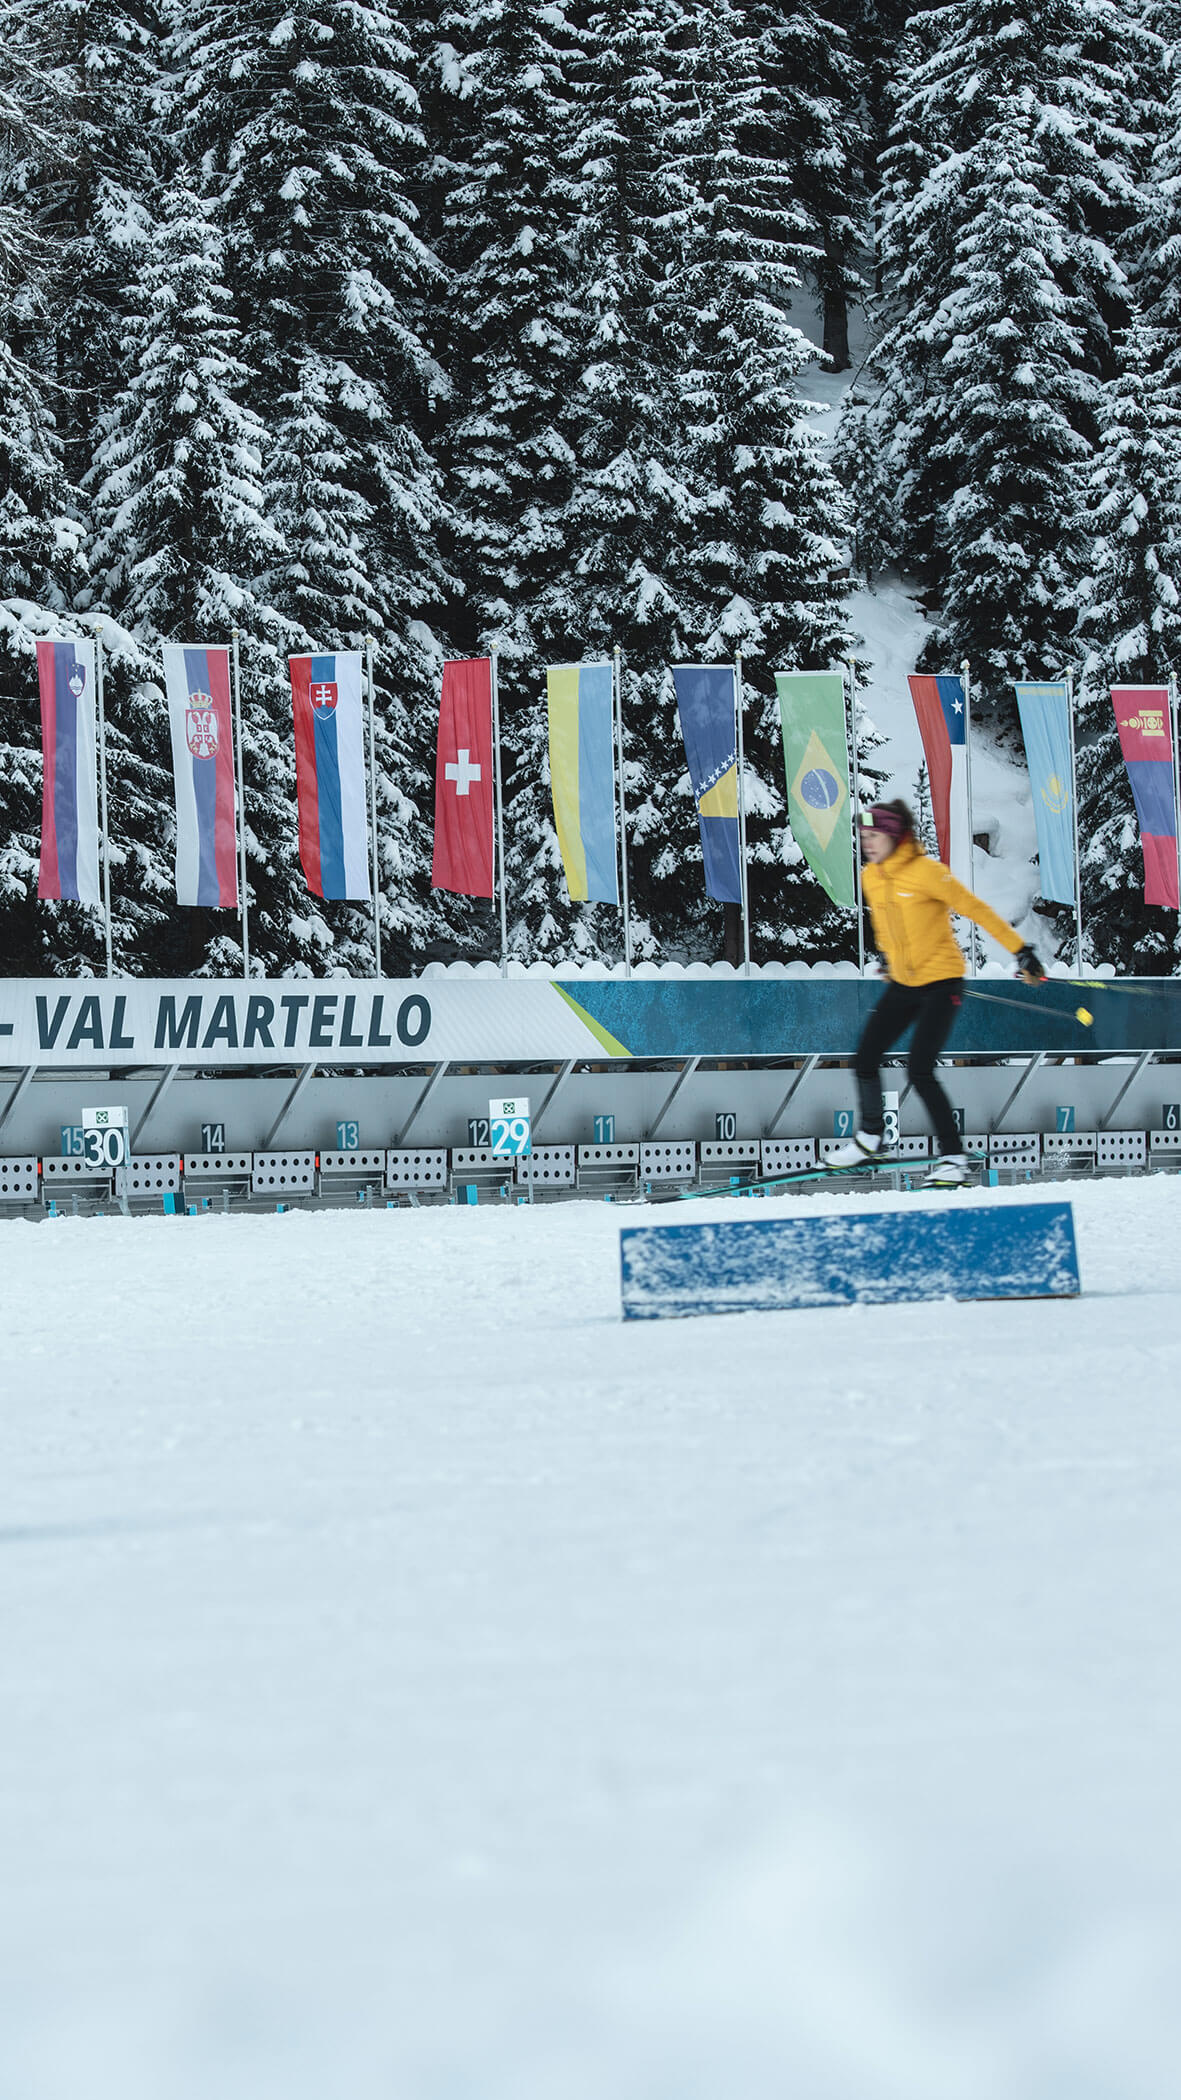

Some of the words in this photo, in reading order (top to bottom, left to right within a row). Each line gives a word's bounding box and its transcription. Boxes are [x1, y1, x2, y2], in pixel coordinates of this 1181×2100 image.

[36, 995, 135, 1050] VAL
[154, 993, 432, 1048] MARTELLO
[595, 1116, 615, 1143] 11
[717, 1114, 736, 1140] 10
[838, 1111, 850, 1137] 9
[1060, 1107, 1071, 1132] 7
[1166, 1105, 1177, 1129] 6
[62, 1127, 83, 1155] 15
[202, 1125, 225, 1152] 14
[337, 1122, 359, 1150] 13
[469, 1119, 489, 1147] 12
[491, 1118, 530, 1155] 29
[84, 1128, 124, 1167] 30
